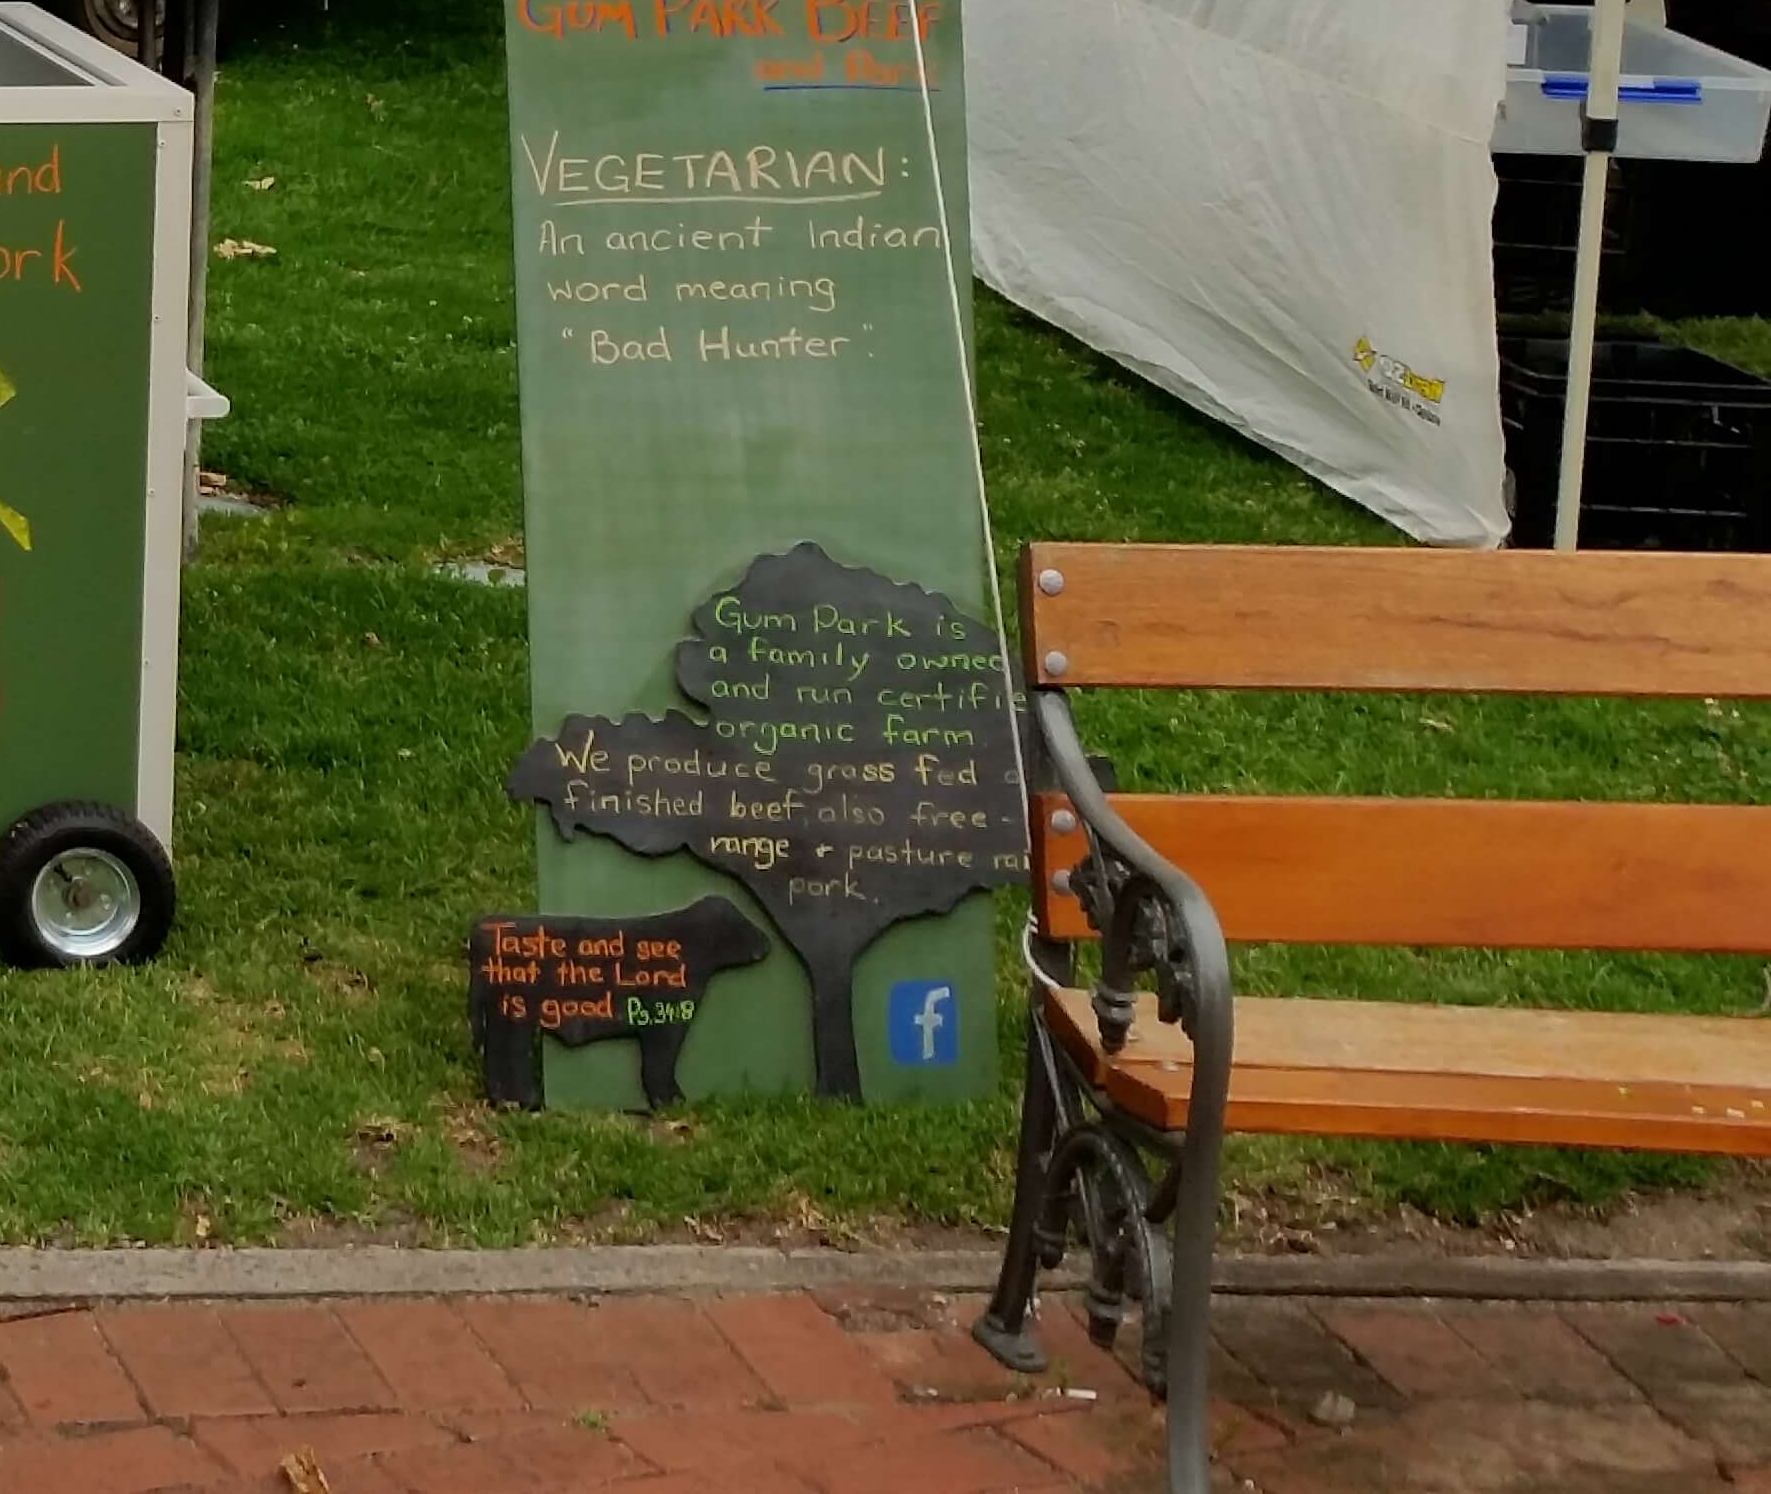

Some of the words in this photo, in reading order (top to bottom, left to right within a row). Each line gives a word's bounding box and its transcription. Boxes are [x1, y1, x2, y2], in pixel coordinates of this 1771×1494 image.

[539, 220, 585, 257] An
[606, 216, 773, 251] ancient
[809, 217, 942, 250] Indian
[546, 274, 647, 302] word
[676, 277, 836, 312] meaning
[715, 597, 797, 633] Gum
[814, 605, 912, 638] Park
[937, 615, 966, 640] is
[709, 646, 729, 664] a
[749, 638, 870, 681] family
[711, 679, 771, 702] and
[796, 686, 853, 706] run
[877, 683, 1028, 714] certifie
[716, 719, 855, 754] organic
[882, 715, 975, 746] farm
[555, 729, 609, 773] We
[627, 748, 777, 784] produce
[808, 763, 896, 793] grass
[915, 752, 977, 787] fed
[563, 780, 705, 818] finished
[817, 793, 885, 826] also
[711, 833, 790, 870] range
[848, 839, 974, 870] pasture
[482, 921, 566, 958] Taste
[578, 930, 625, 958] and
[635, 939, 682, 959] see
[482, 960, 540, 985] that
[557, 959, 605, 985] the
[615, 960, 686, 988] Lord
[501, 993, 527, 1013] is
[539, 993, 614, 1029] good
[912, 986, 951, 1060] f
